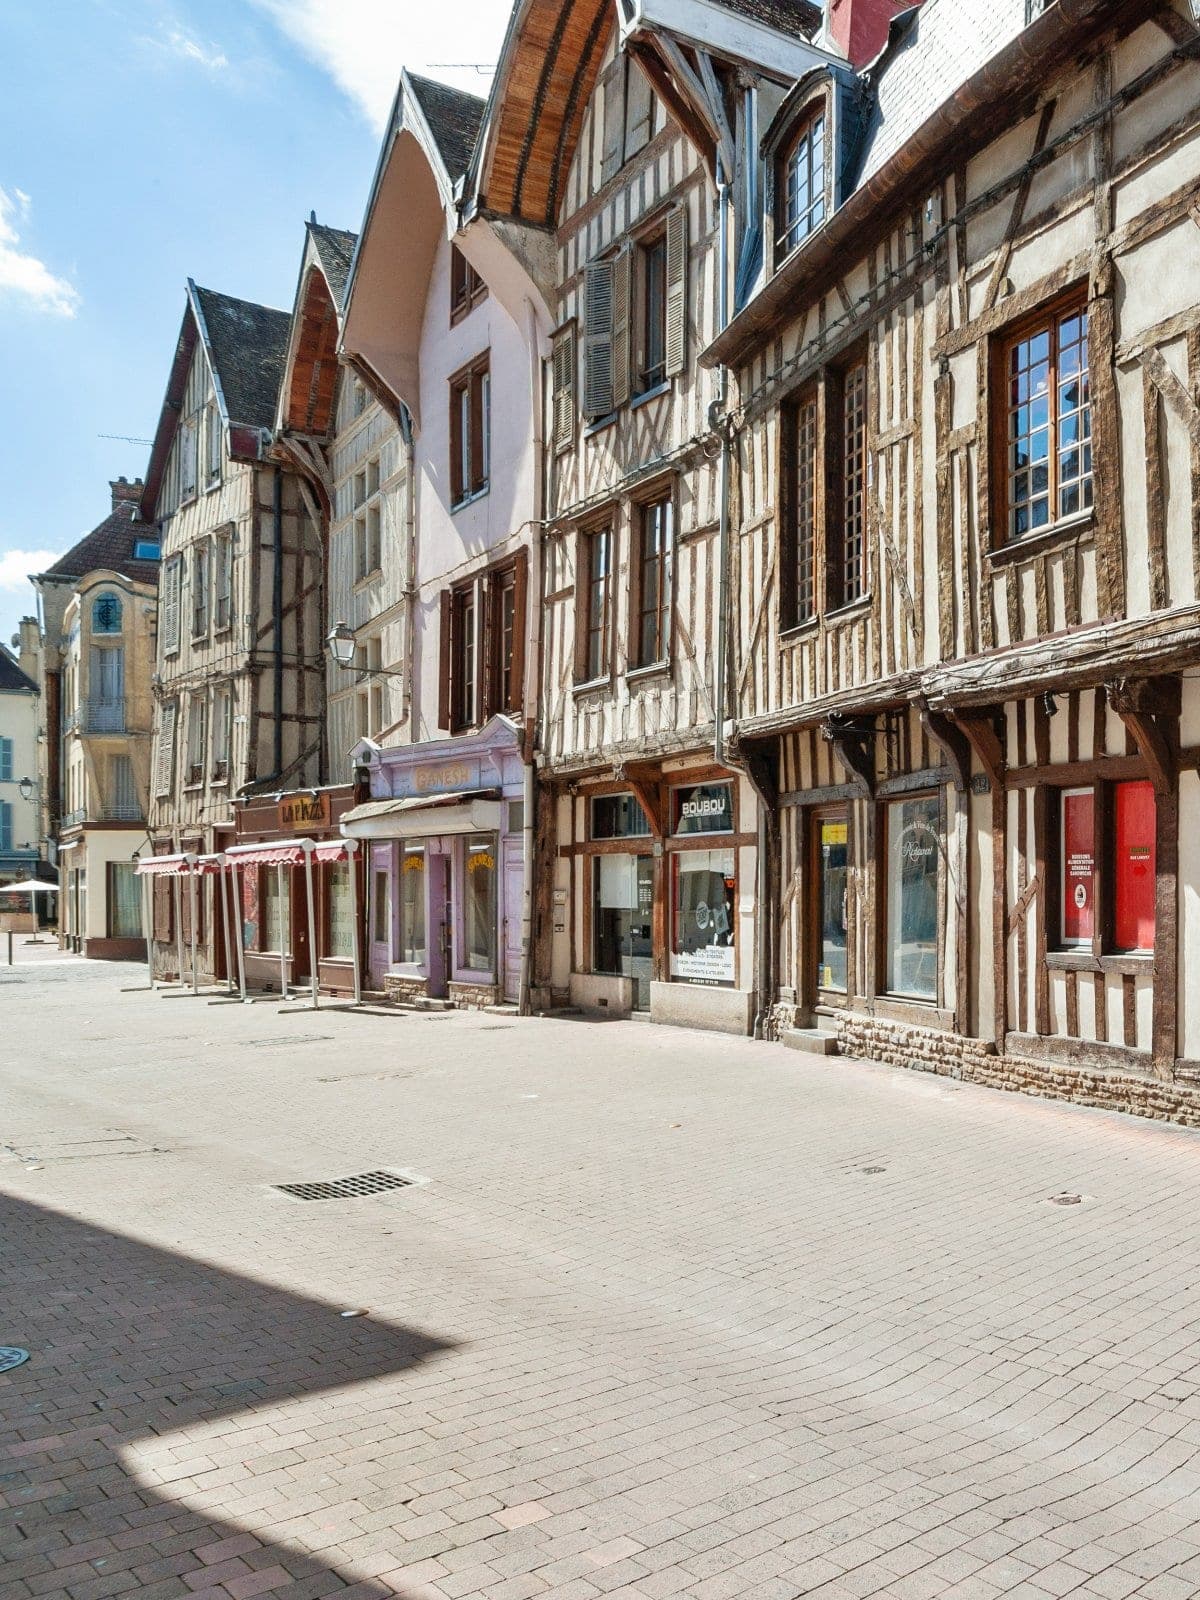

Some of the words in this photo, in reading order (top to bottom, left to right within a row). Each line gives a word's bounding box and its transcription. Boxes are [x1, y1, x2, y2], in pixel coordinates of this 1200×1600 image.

[415, 764, 470, 790] GANESH
[281, 805, 294, 823] LA
[682, 798, 726, 815] BOUBOU
